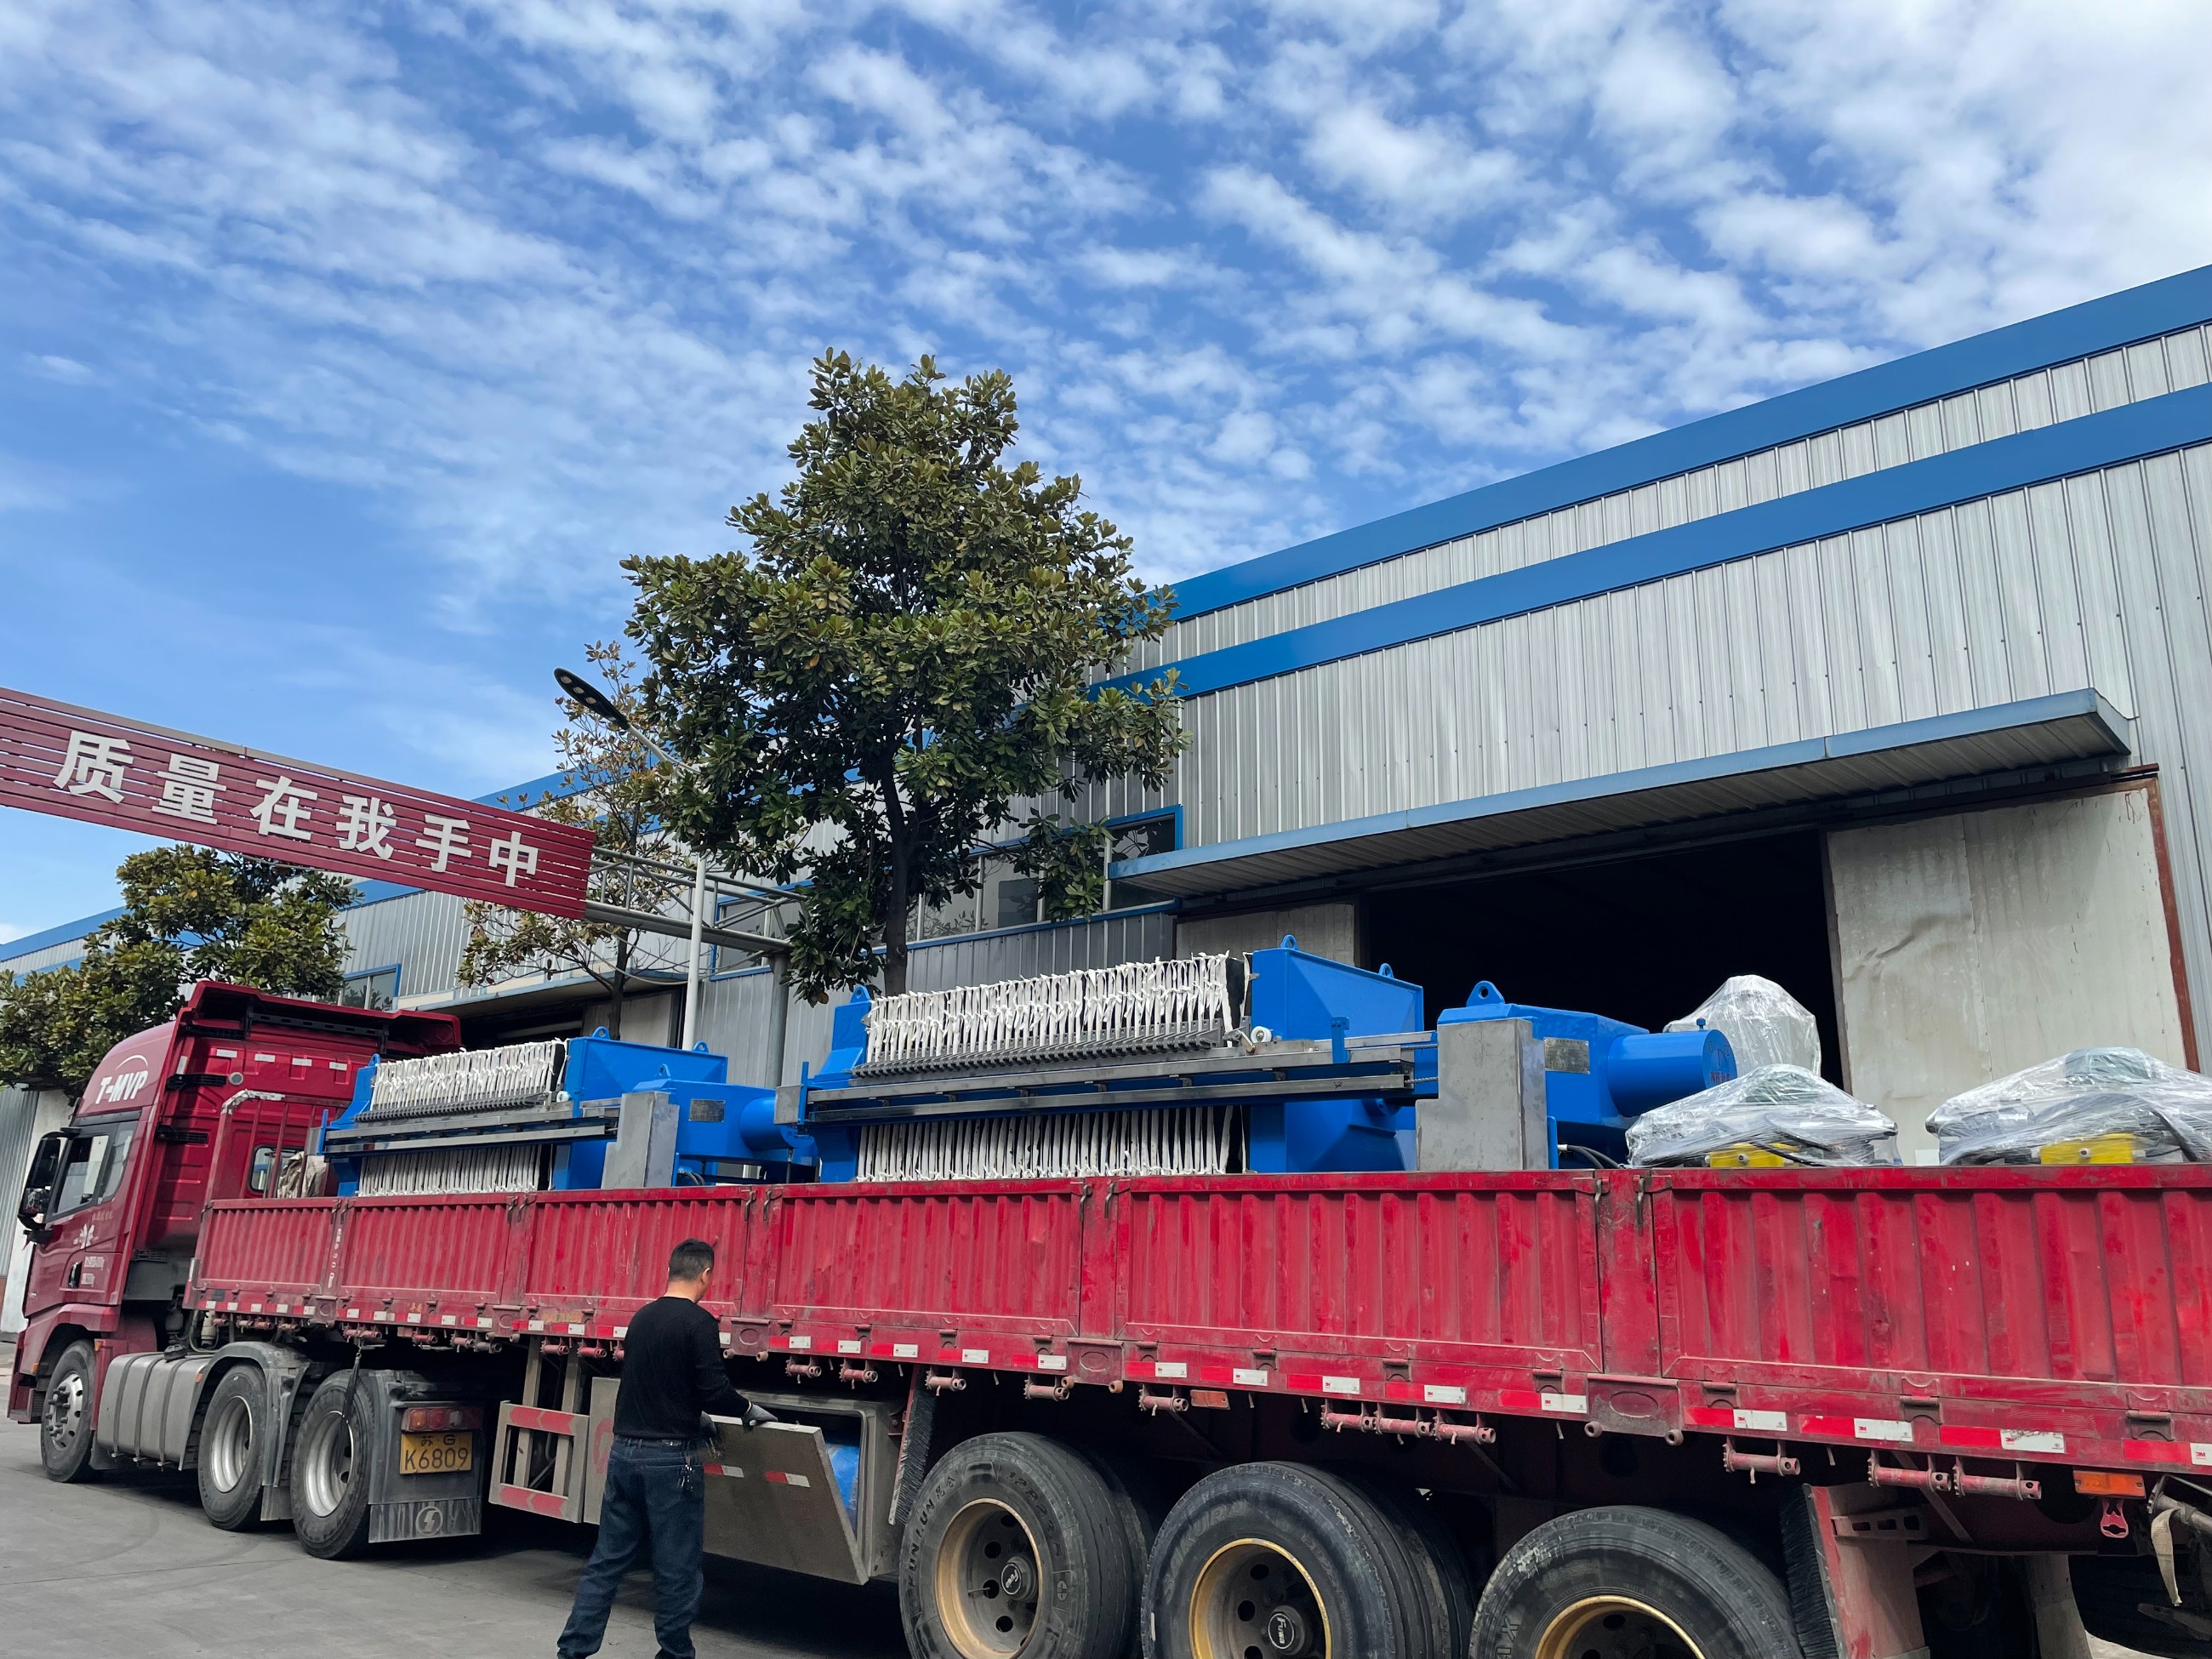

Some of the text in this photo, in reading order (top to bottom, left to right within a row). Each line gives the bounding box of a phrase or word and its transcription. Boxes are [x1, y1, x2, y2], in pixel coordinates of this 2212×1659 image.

[53, 728, 539, 888] 质量在我手中
[95, 1070, 148, 1104] T-MVP
[405, 1447, 468, 1470] K6809
